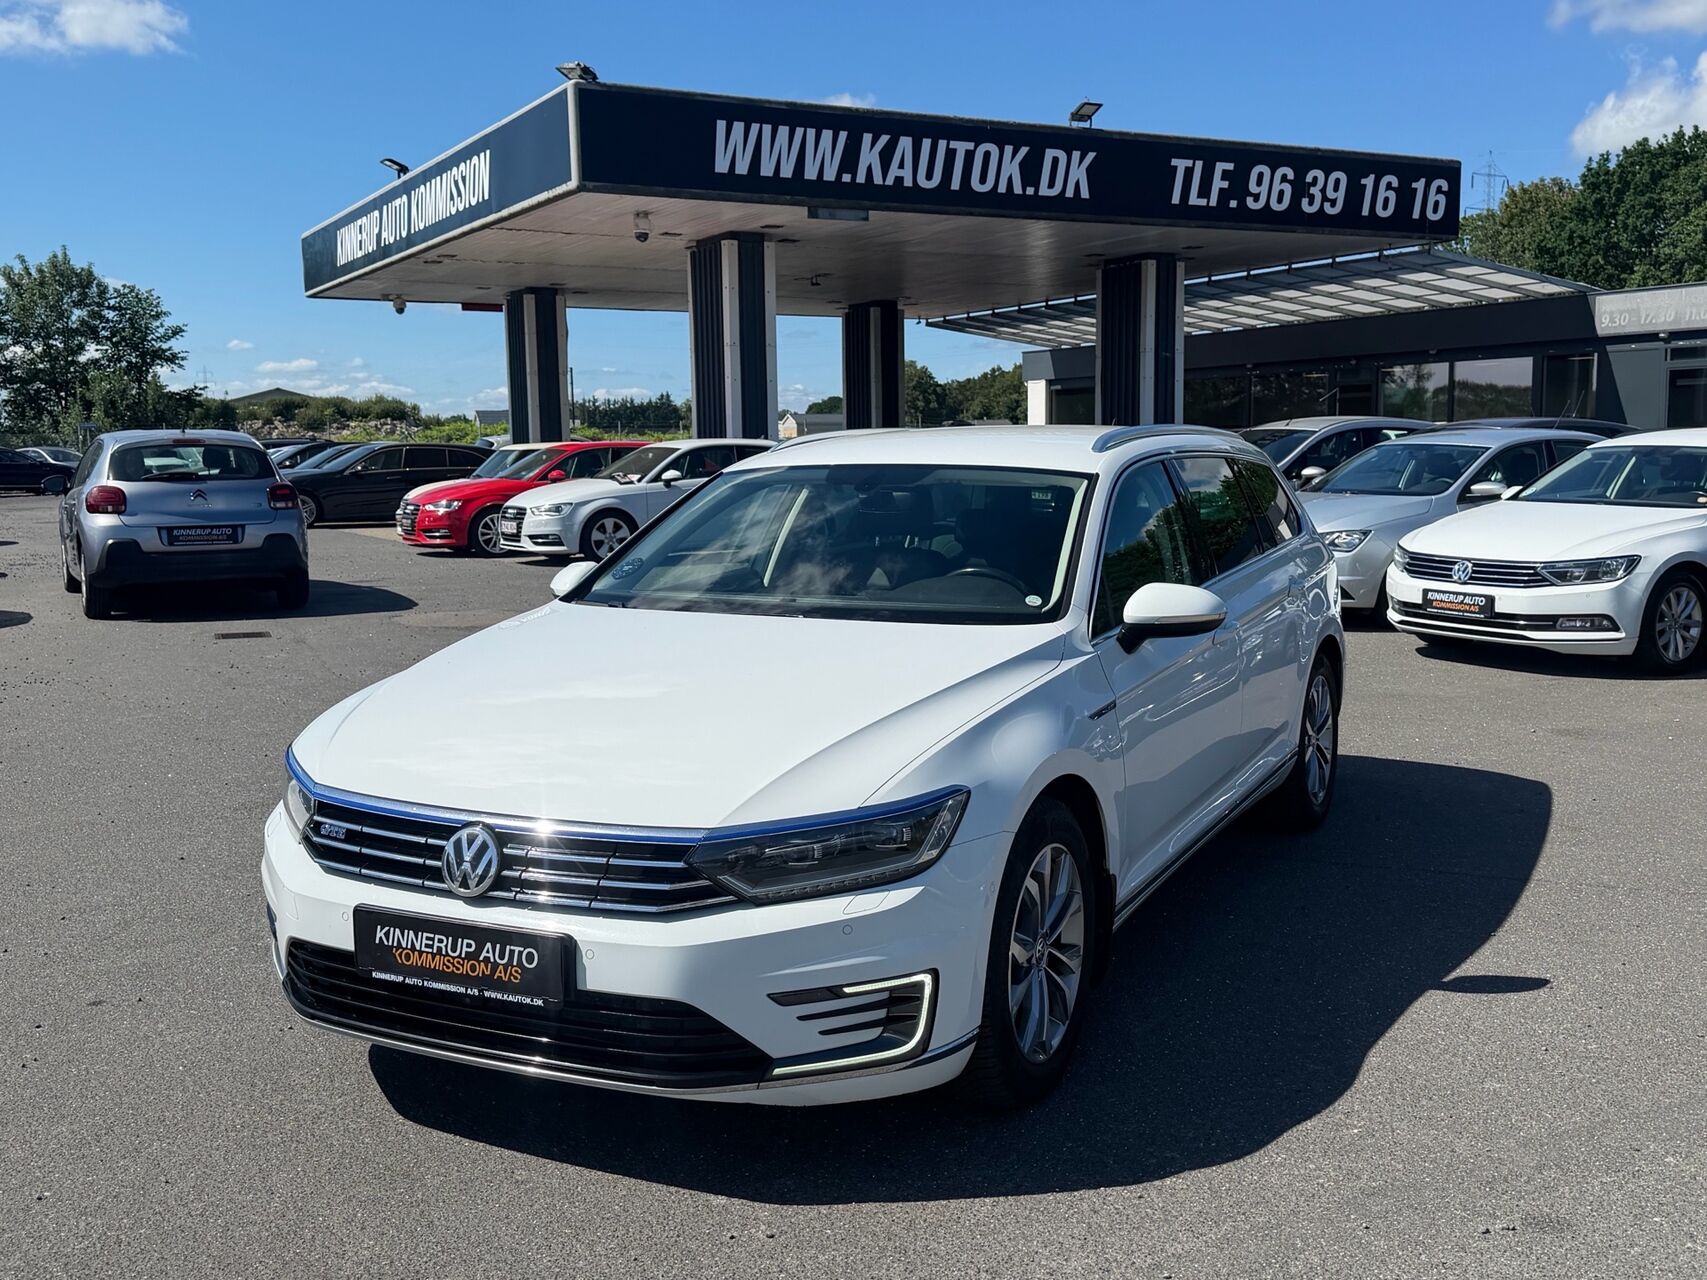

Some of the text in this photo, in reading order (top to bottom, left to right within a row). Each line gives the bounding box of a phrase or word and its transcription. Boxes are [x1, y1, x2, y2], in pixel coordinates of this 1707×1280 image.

[714, 119, 1449, 221] WWW.KAUTOK.DK TLF. 96 39 16 16
[337, 149, 491, 267] KINNERUP AUTO KOMMISSION
[1601, 312, 1629, 327] 9.30
[173, 527, 233, 536] KINNERUP AUTO
[1427, 591, 1486, 606] KINNERUP AUTO
[1432, 600, 1470, 610] KOMMISSION
[375, 925, 539, 968] KINNERUP AUTO
[392, 947, 522, 983] KOMMISSION A/S
[372, 971, 404, 983] KINNERUP
[405, 976, 422, 986] AUTO
[423, 977, 466, 994] KOMMISSION
[467, 988, 479, 996] A/S
[483, 990, 544, 1007] WWW.KAUTOK.DK
